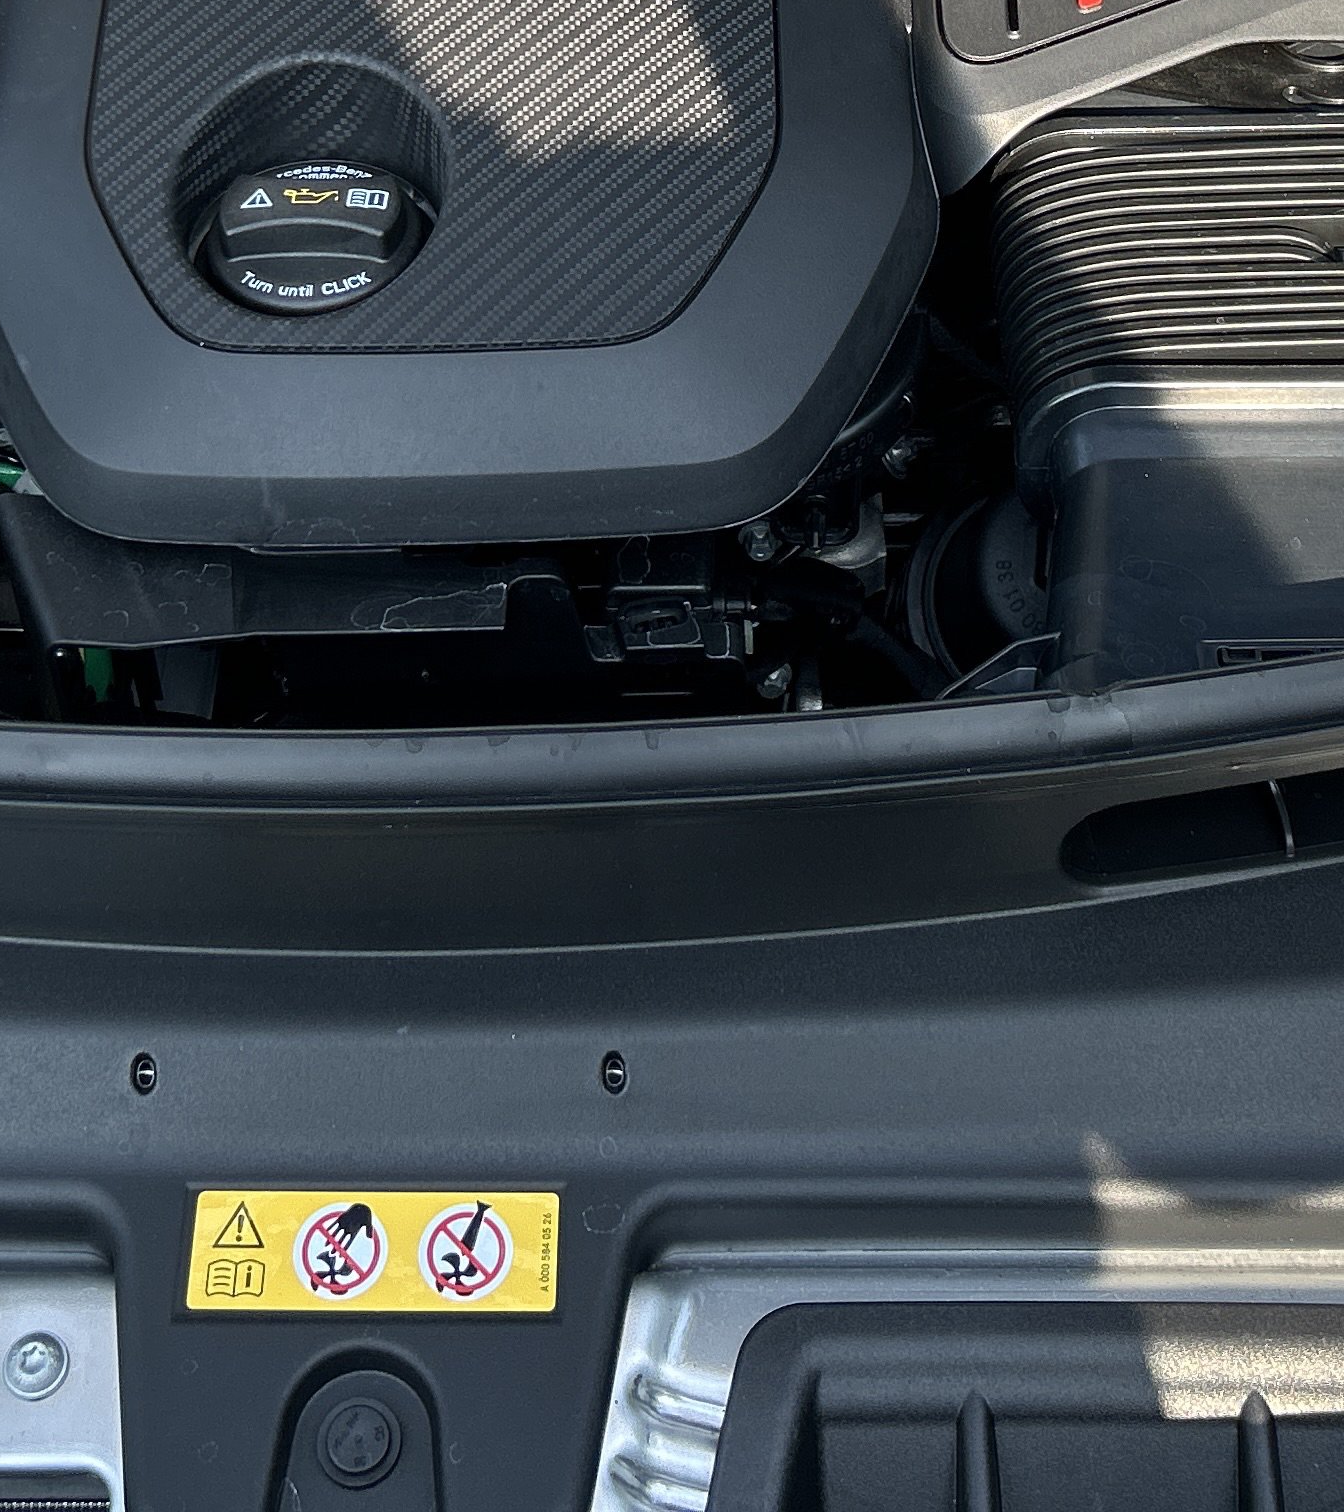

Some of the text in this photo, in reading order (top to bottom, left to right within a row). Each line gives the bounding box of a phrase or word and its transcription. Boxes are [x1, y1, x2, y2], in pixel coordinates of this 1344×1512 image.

[240, 270, 372, 297] Turn until CLICK
